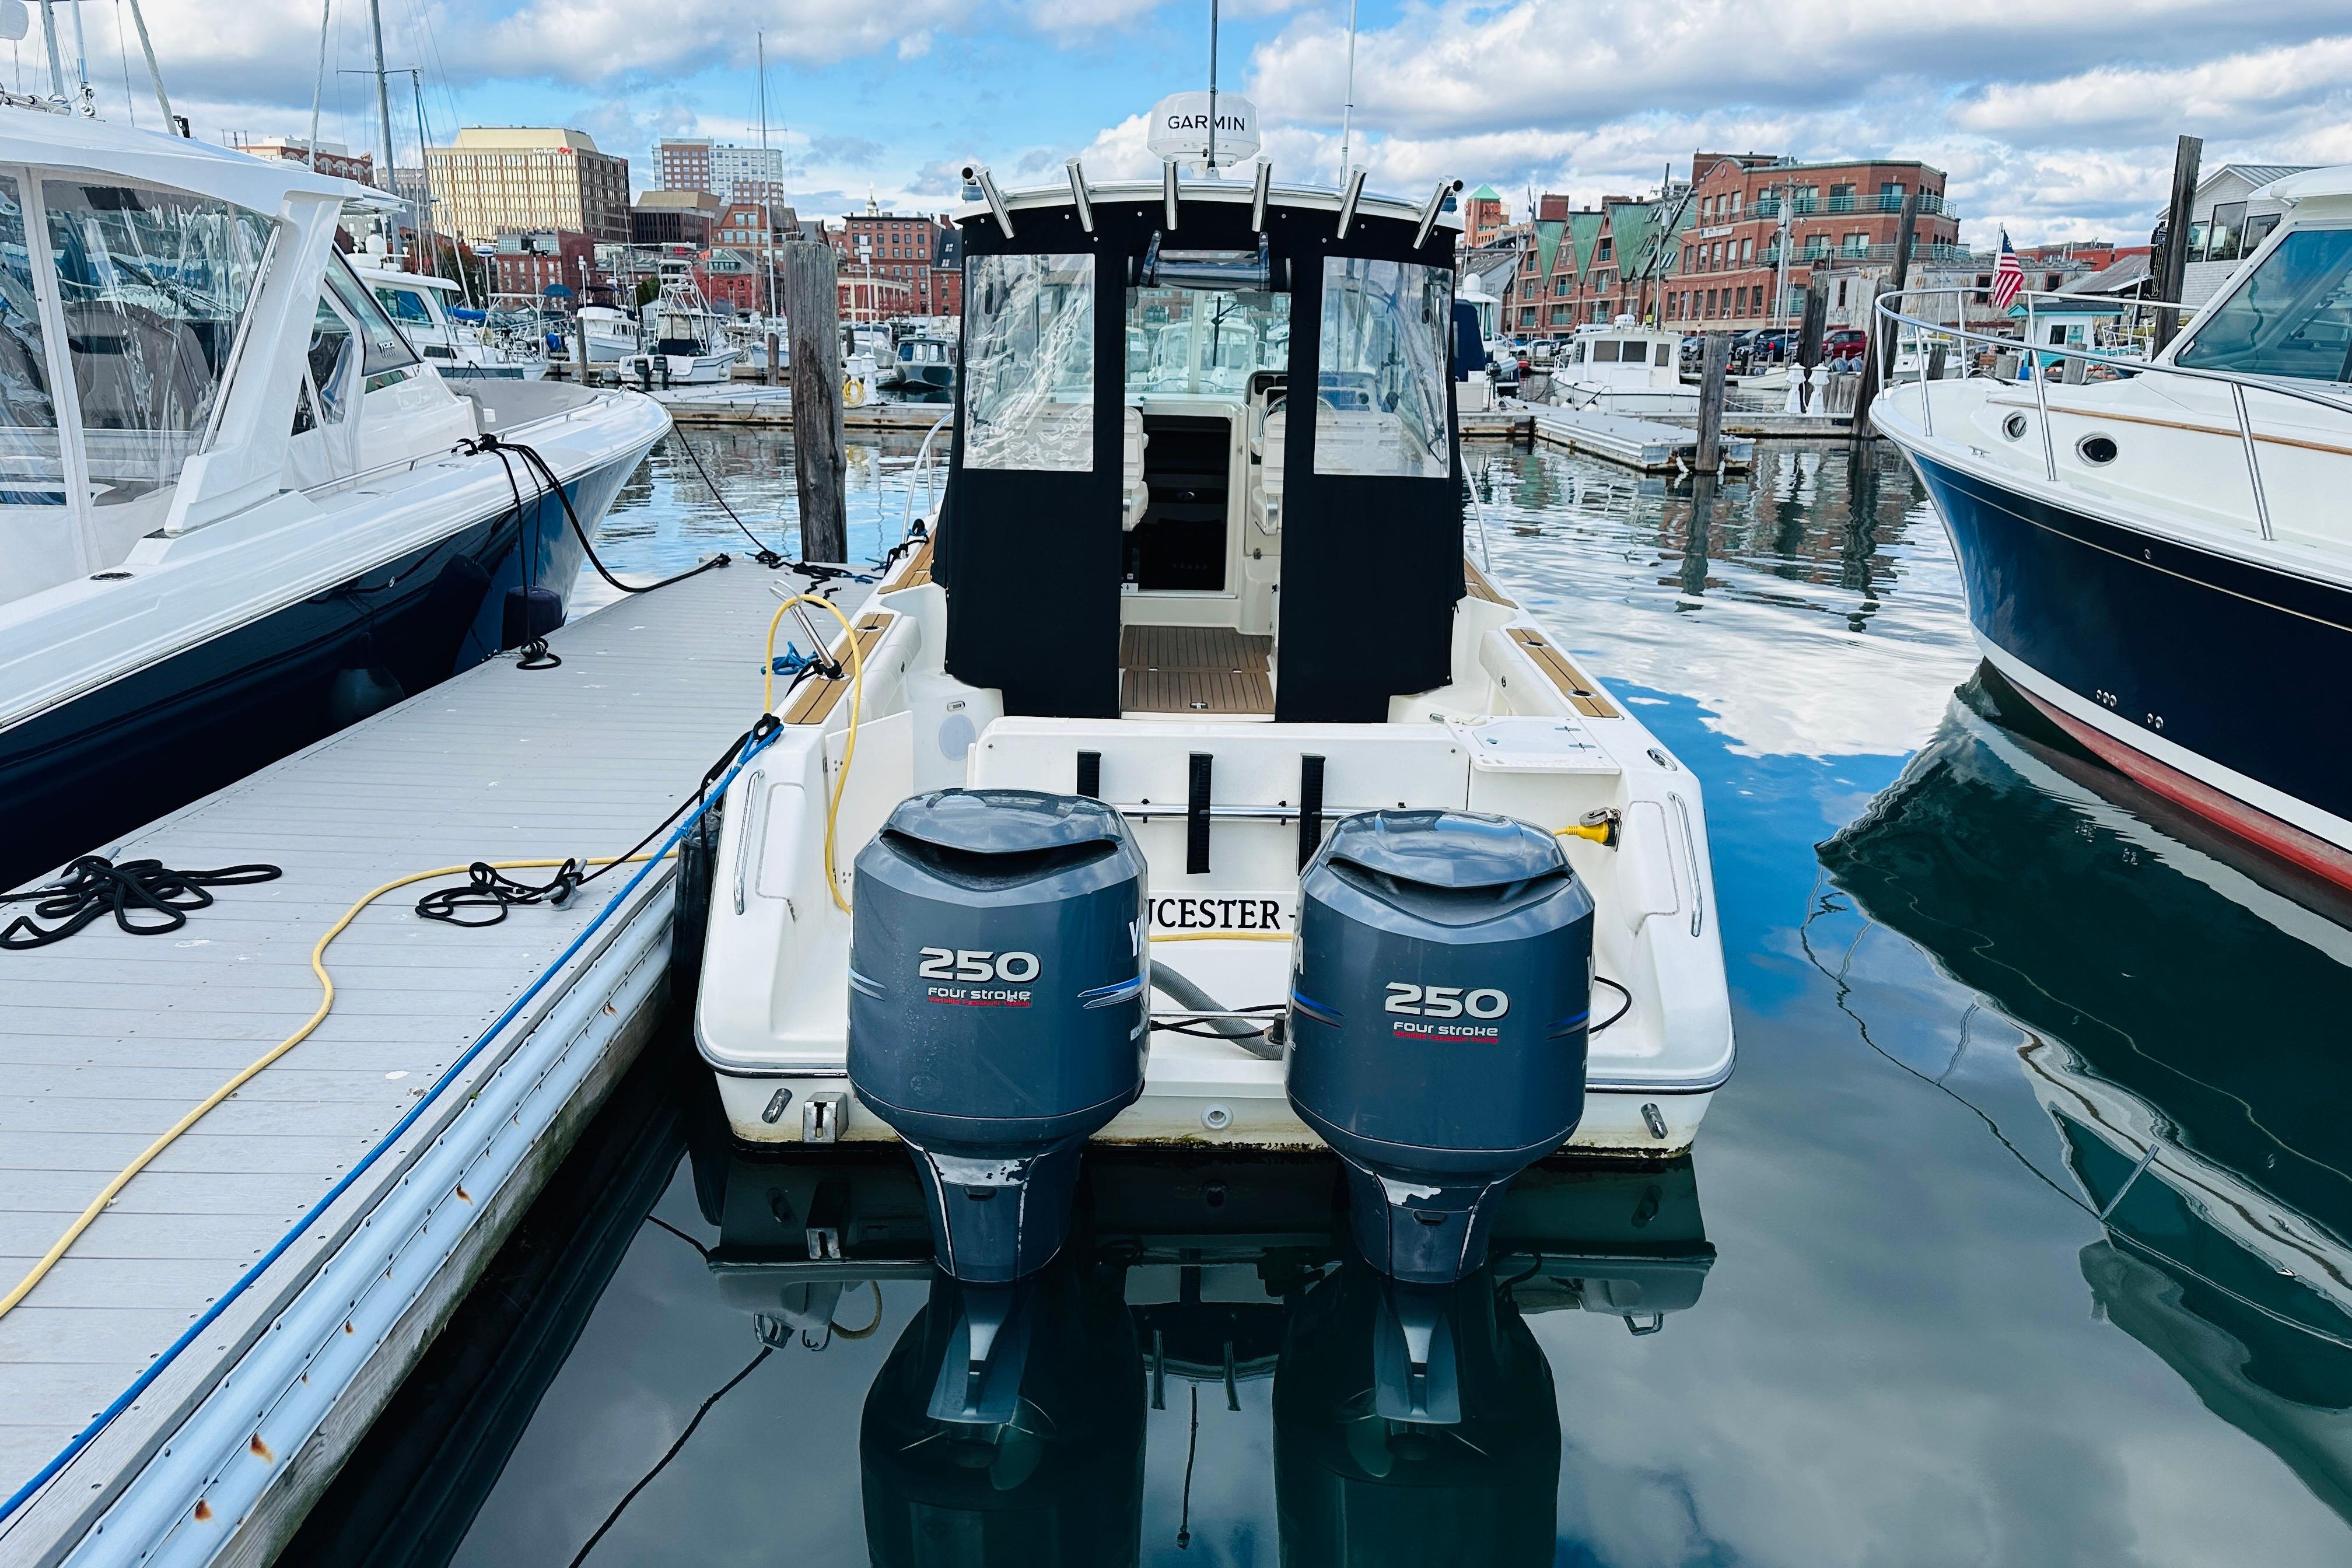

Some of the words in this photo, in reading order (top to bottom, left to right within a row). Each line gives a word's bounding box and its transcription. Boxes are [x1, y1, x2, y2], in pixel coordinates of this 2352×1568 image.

[1168, 115, 1245, 131] GARMIN
[919, 947, 1040, 982] 250
[1385, 982, 1509, 1019] 250
